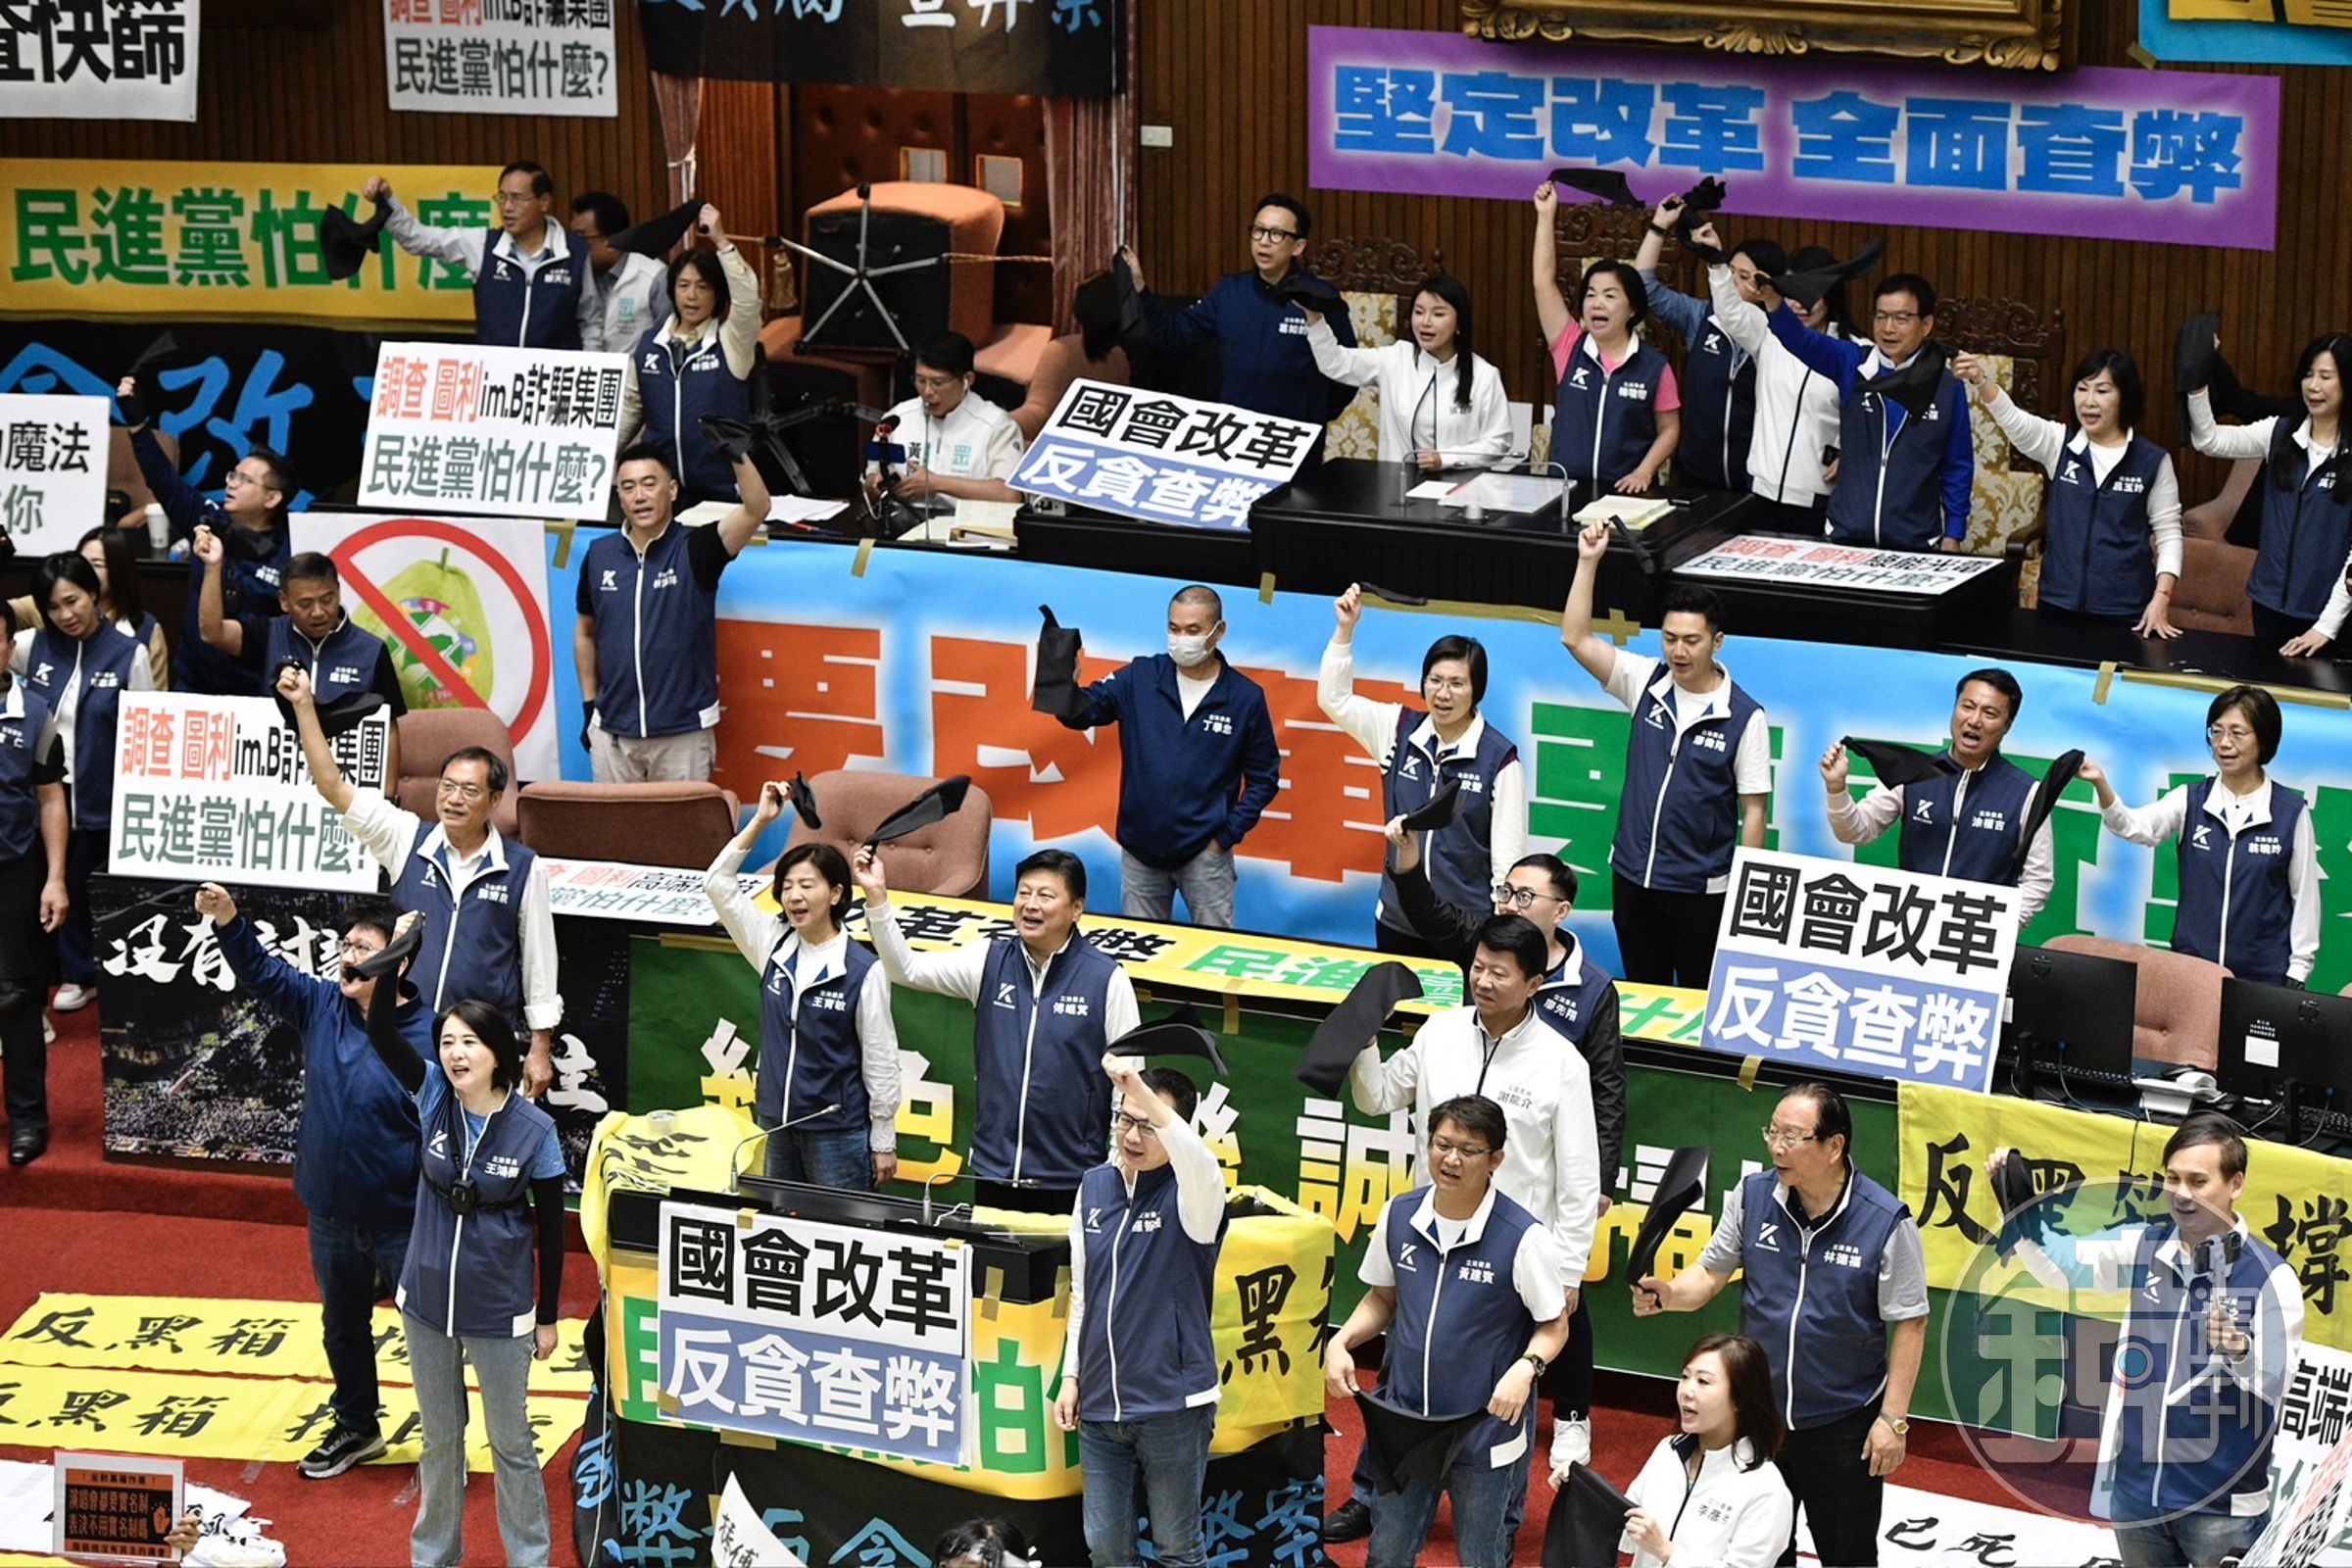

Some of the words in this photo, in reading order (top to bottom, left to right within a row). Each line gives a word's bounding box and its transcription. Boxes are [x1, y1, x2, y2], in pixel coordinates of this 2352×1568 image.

[394, 37, 610, 99] 民進黨怕什麼?
[1335, 65, 1765, 174] 堅定改革
[1791, 90, 2243, 204] 全面查弊
[376, 357, 429, 419] 調查
[430, 359, 623, 430] 圖利im.B詐騙集團
[1056, 384, 1311, 469] 國會改革
[0, 421, 90, 474] 魔法
[367, 433, 608, 506] 民進黨怕什麼?
[1018, 443, 1275, 528] 反貪查弊
[1686, 556, 1955, 587] 民進黨怕什麼?
[1718, 538, 1803, 559] 調查
[122, 706, 175, 777] 調查
[180, 710, 386, 790] 圖利im.B詐集團
[1729, 860, 2008, 975] 國會改革
[1708, 965, 1991, 1082] 反貪查弊
[669, 1215, 958, 1337] 國會改革
[10, 1306, 301, 1358] 反黑箱
[665, 1326, 958, 1448] 反貪查弊
